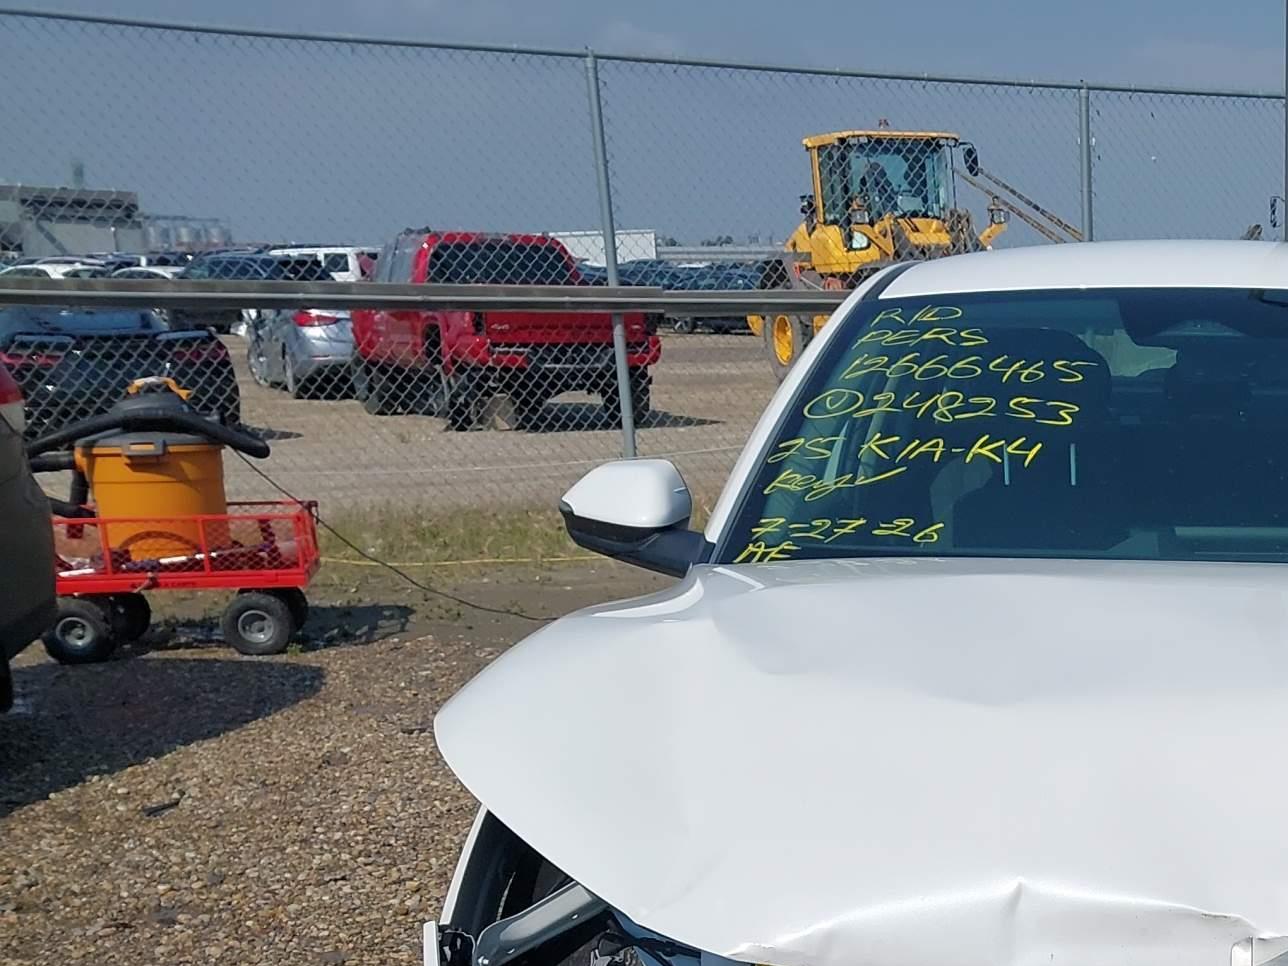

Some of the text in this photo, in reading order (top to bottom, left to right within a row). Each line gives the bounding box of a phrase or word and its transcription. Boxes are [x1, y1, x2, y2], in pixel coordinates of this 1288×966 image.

[851, 327, 989, 350] PERS
[840, 352, 1099, 385] 12666465
[853, 391, 1081, 425] 248253
[857, 432, 1043, 468] KIA-K4
